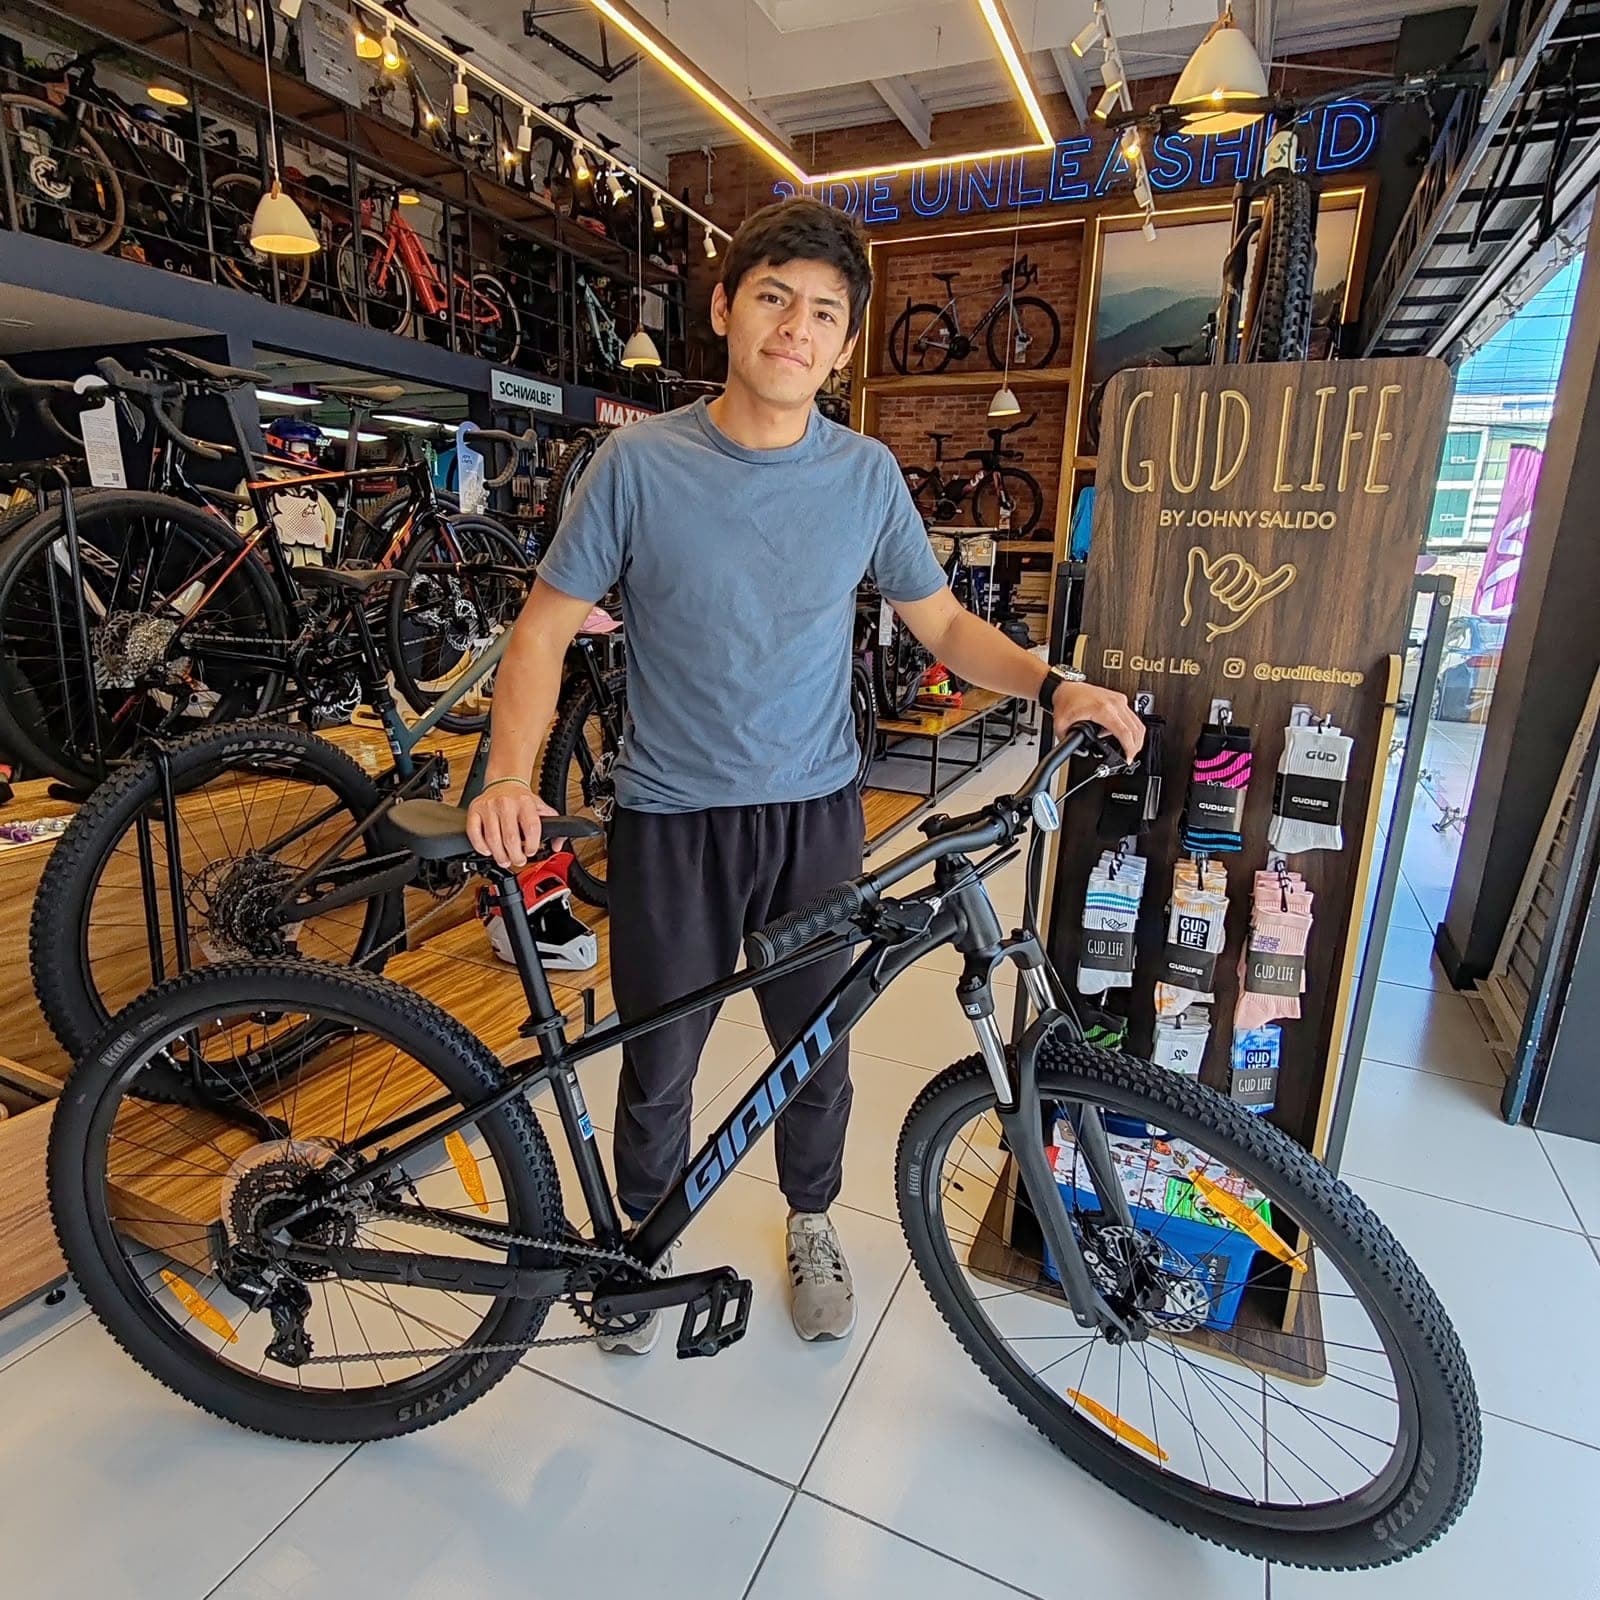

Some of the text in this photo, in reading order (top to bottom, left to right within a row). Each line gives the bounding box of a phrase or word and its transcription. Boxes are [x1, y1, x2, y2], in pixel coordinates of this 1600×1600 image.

[772, 170, 898, 223] DE
[499, 381, 553, 406] SCHWALBE
[599, 401, 651, 428] MAXX
[1121, 385, 1401, 493] GUD LIFE
[1160, 510, 1337, 530] BY JOHNY SALIDO
[1129, 655, 1164, 673] Gud
[1253, 662, 1364, 687] @gudlifeshop
[222, 741, 307, 754] MAXXIS
[1306, 750, 1337, 762] GUD
[1180, 917, 1208, 933] GUD
[1087, 939, 1124, 957] GUD LIFE
[1180, 931, 1205, 947] LIFE
[1254, 963, 1294, 982] GUD LIFE
[100, 1031, 136, 1067] IKON
[1246, 1052, 1270, 1064] GUD
[1238, 1077, 1272, 1093] GUD LIFE
[684, 993, 839, 1212] GIANT
[908, 1163, 920, 1196] IKON
[398, 1353, 489, 1421] MAXXIS
[1374, 1444, 1435, 1540] MAXXIS
